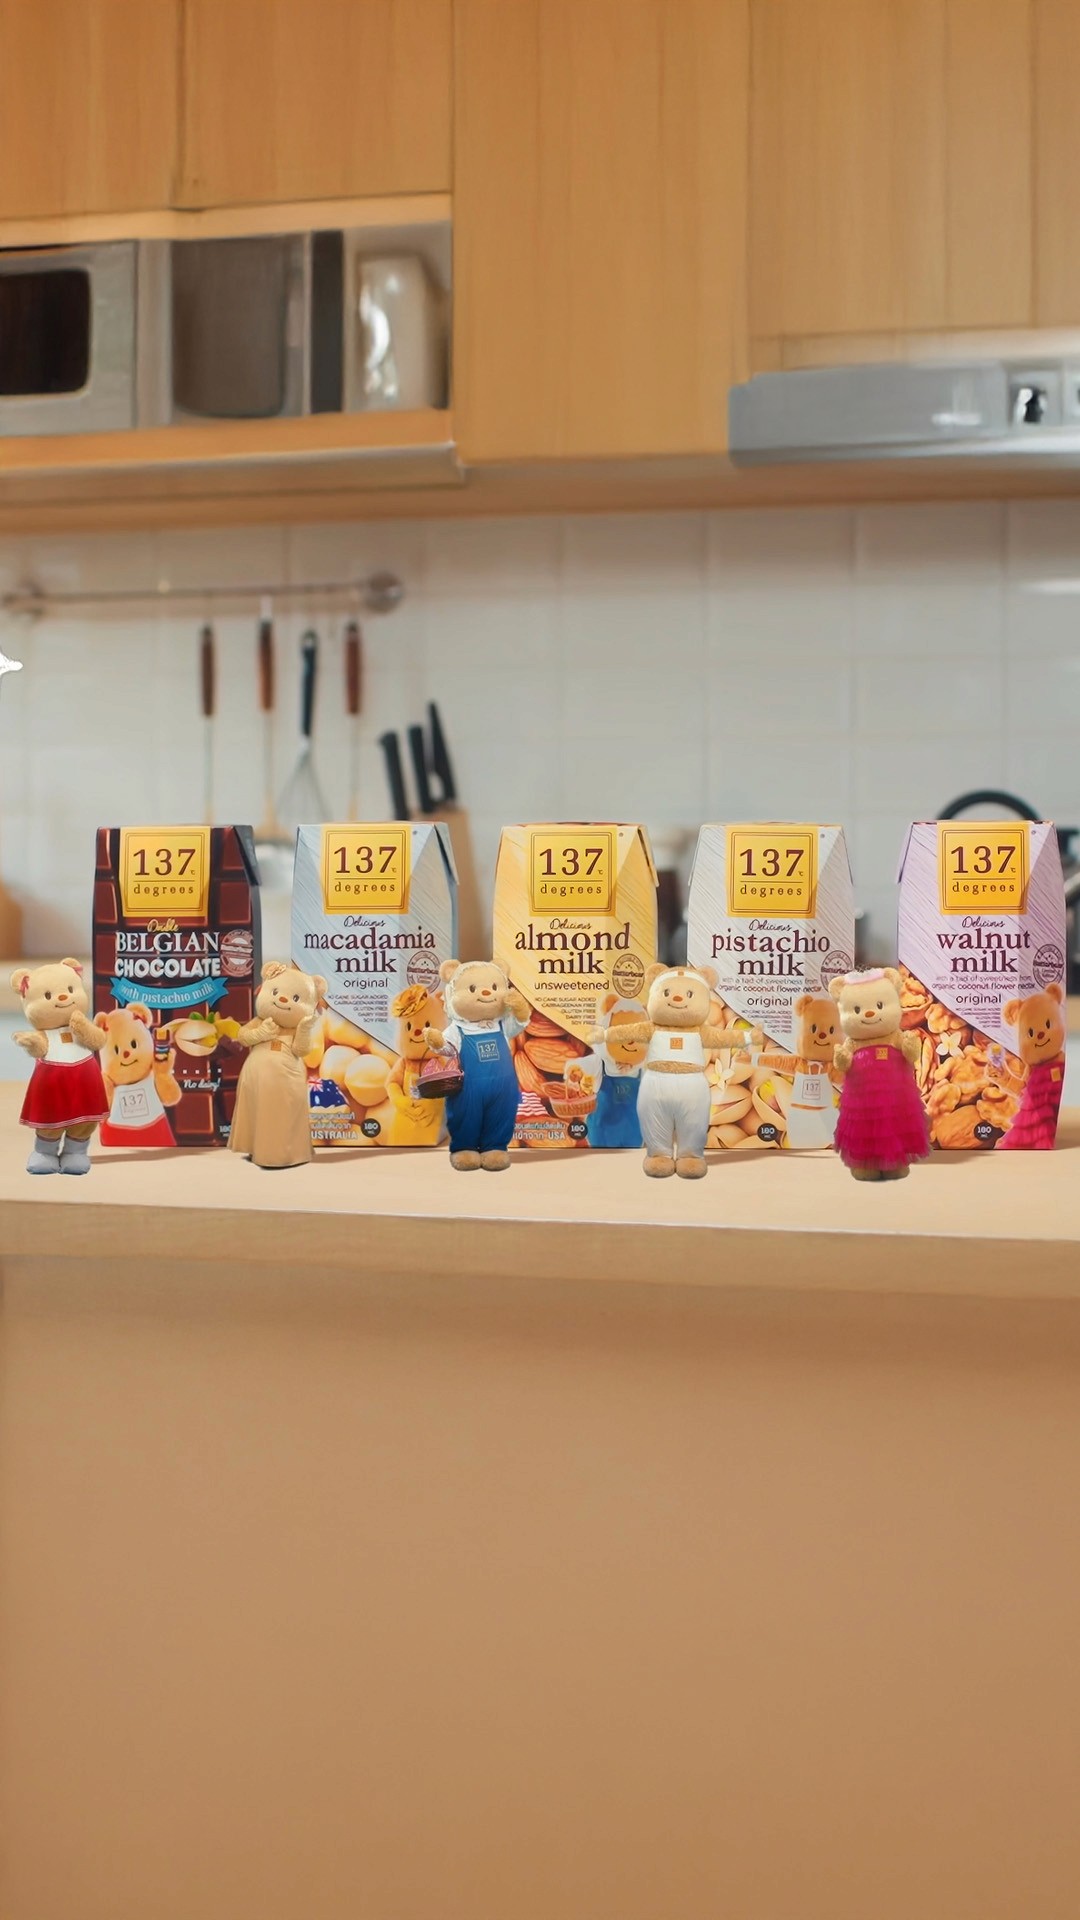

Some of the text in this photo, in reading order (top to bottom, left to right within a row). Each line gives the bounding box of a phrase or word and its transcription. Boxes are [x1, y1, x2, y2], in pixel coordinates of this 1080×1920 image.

[133, 849, 196, 876] 137
[333, 846, 397, 874] 137
[539, 848, 603, 875] 137
[739, 848, 804, 877] 137
[950, 846, 1016, 874] 137
[133, 884, 194, 897] degrees
[335, 881, 395, 894] degrees
[540, 883, 602, 897] degrees
[740, 884, 802, 898] degrees
[952, 882, 1015, 895] degrees
[343, 915, 386, 928] Delicious
[550, 918, 591, 930] Delicious
[749, 919, 792, 931] Delicious
[961, 916, 1005, 928] Delicious
[116, 932, 220, 952] BELGIAN
[304, 925, 436, 950] macadamia
[515, 922, 630, 951] almond
[711, 928, 830, 958] pistachio
[936, 928, 1031, 949] walnut
[114, 958, 221, 978] CHOCOLATE
[335, 950, 397, 973] milk
[538, 951, 604, 975] milk
[738, 953, 804, 976] milk
[950, 950, 1018, 973] milk
[343, 977, 388, 989] original
[534, 980, 609, 990] unsweetened
[776, 984, 801, 992] flower
[932, 983, 955, 991] organic
[957, 982, 989, 990] coconut
[991, 982, 1015, 990] flower
[121, 982, 214, 1003] with pistachio milk
[747, 996, 792, 1008] original
[956, 994, 1002, 1006] original
[480, 1043, 496, 1053] 137
[183, 1079, 221, 1092] No dairy!
[122, 1093, 143, 1106] 137
[364, 1122, 379, 1130] 180
[977, 1126, 992, 1134] 180
[310, 1130, 358, 1139] USTRALIA
